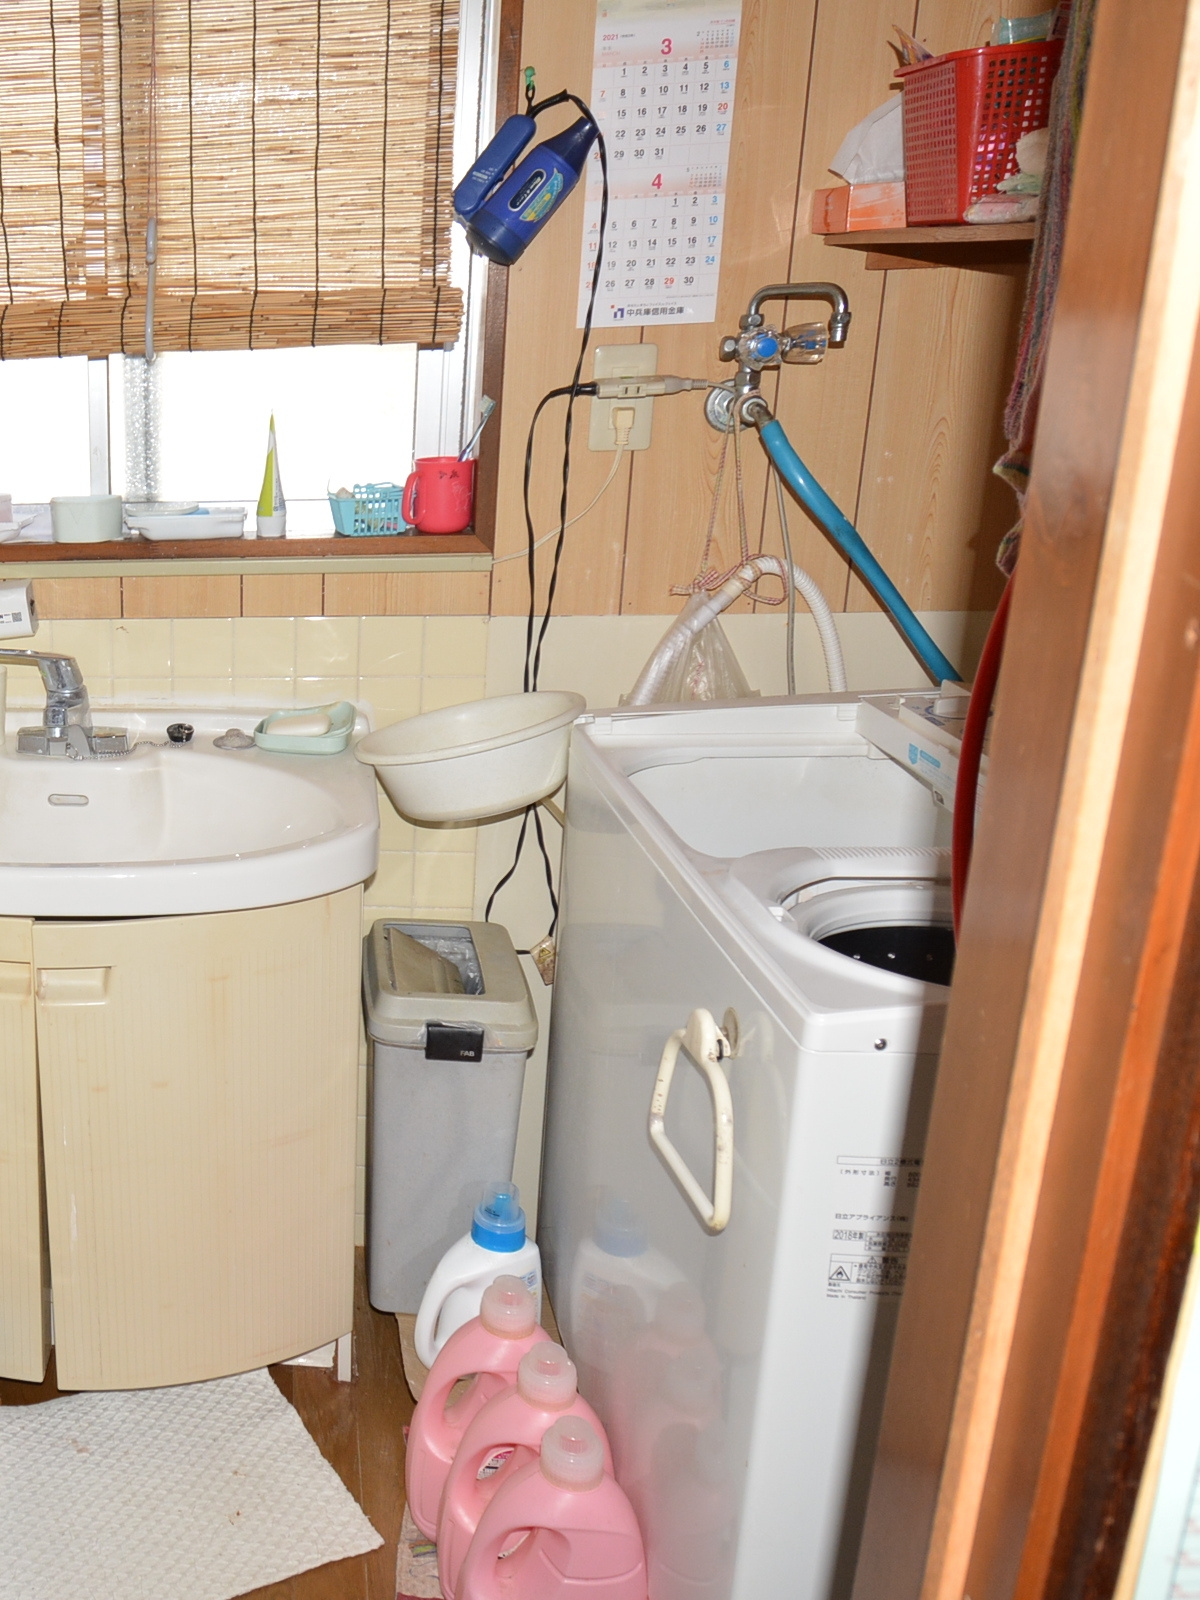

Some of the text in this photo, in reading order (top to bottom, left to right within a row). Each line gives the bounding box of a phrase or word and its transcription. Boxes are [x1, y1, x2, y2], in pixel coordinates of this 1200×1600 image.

[660, 38, 672, 55] 3
[642, 66, 648, 74] 2
[662, 64, 668, 72] 3
[703, 62, 709, 70] 5
[724, 60, 730, 68] 6
[620, 89, 626, 97] 8
[640, 87, 646, 95] 9
[659, 86, 669, 94] 10
[700, 83, 710, 91] 12
[720, 82, 730, 90] 13
[698, 104, 708, 112] 19
[615, 123, 726, 138] 22 23 24 25 26 27
[614, 150, 624, 158] 29
[654, 148, 664, 156] 31
[651, 173, 662, 190] 4
[611, 221, 617, 229] 5
[668, 238, 677, 246] 15
[646, 258, 656, 266] 21
[644, 278, 655, 286] 28
[626, 306, 684, 316] 中兵庫信用金庫
